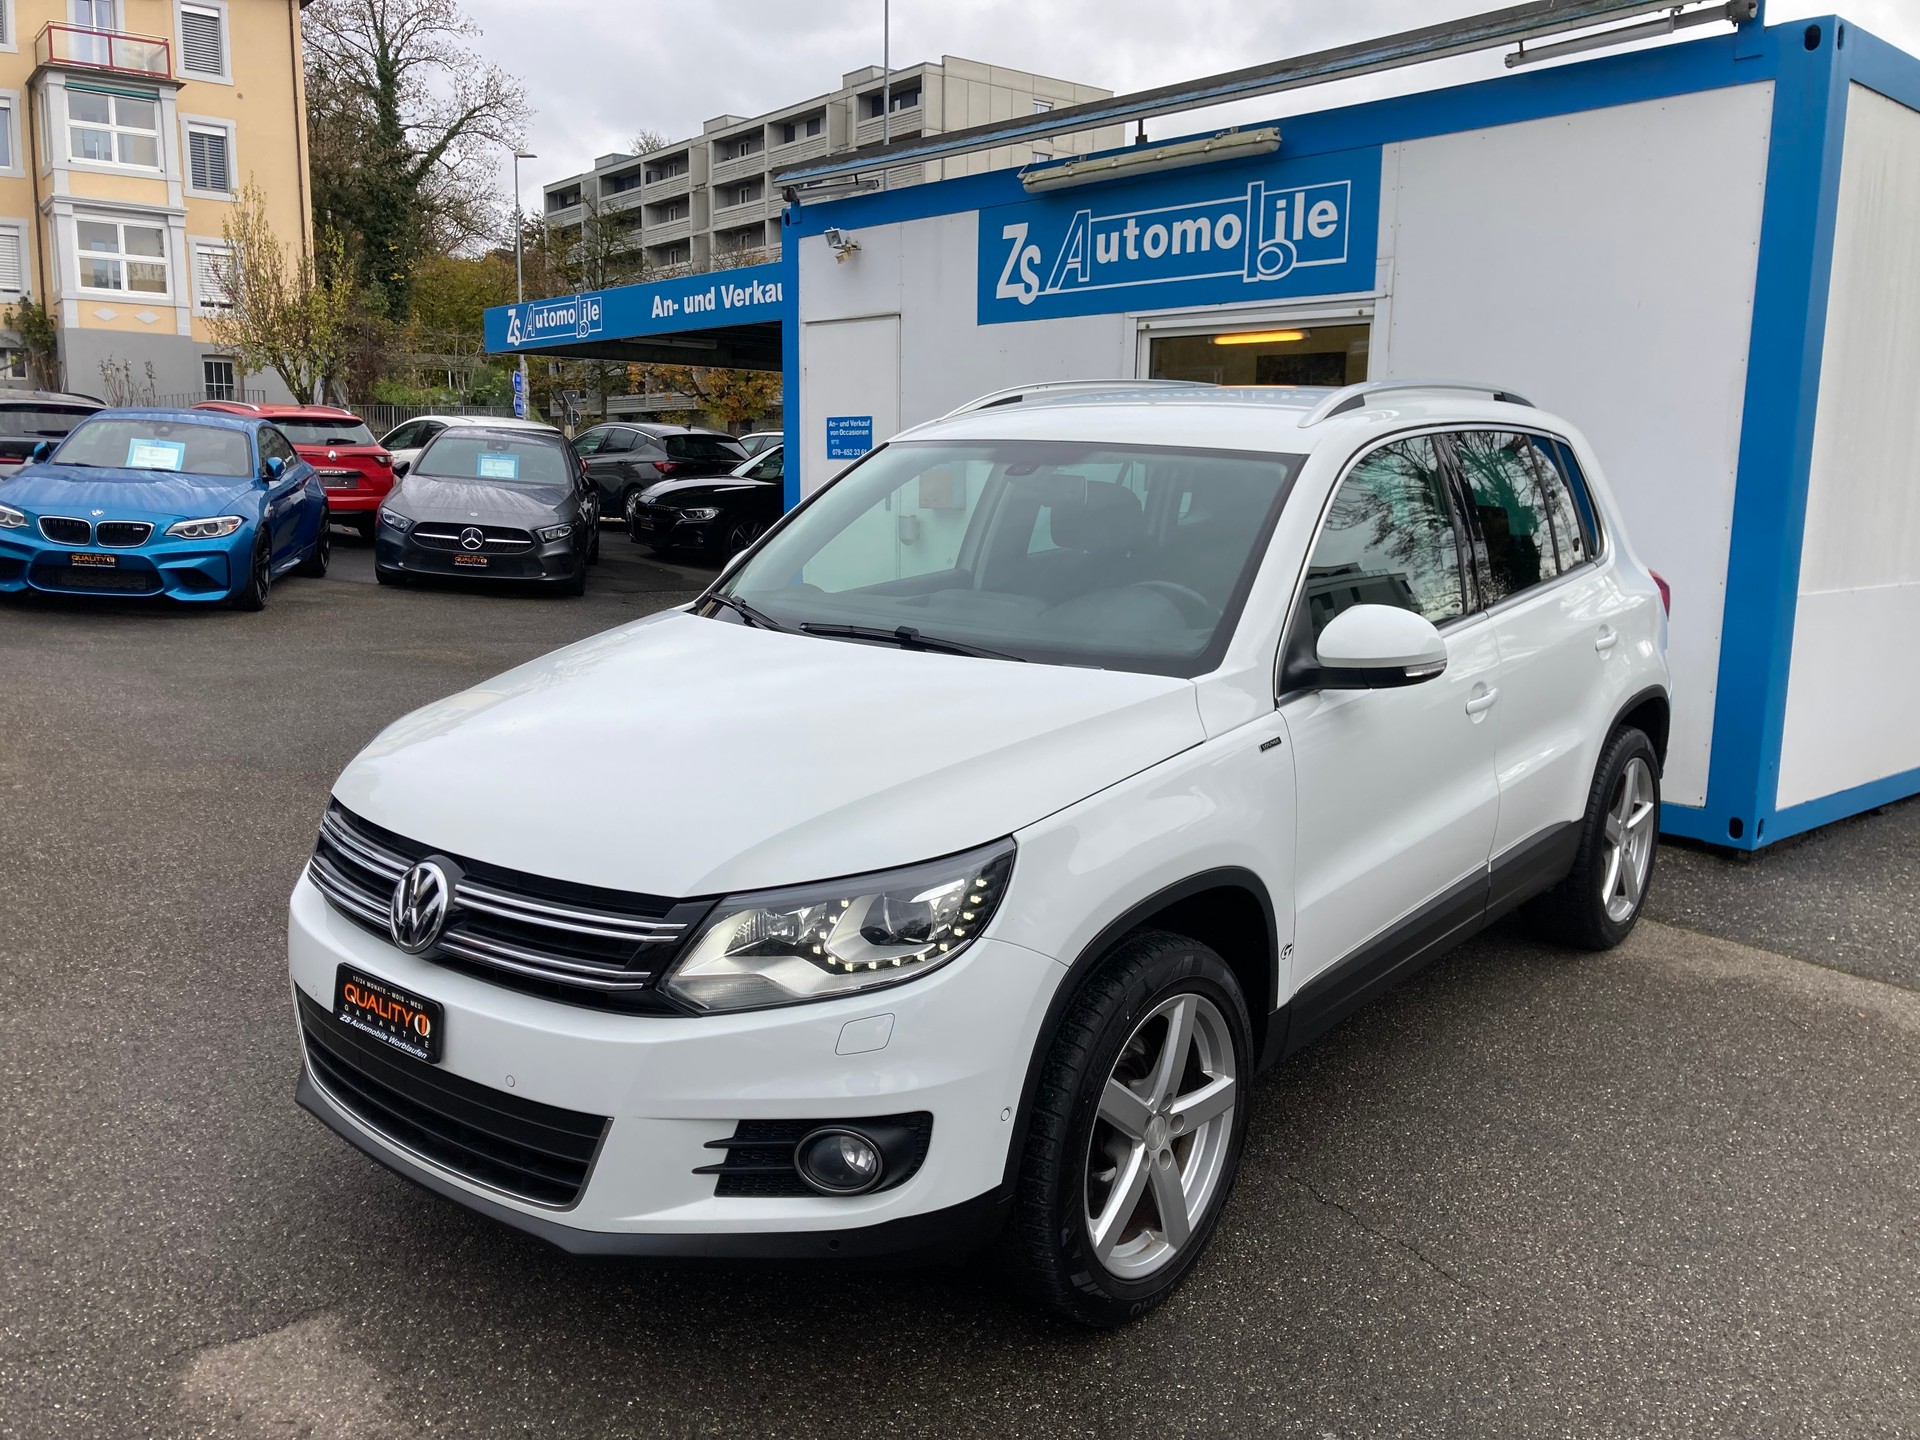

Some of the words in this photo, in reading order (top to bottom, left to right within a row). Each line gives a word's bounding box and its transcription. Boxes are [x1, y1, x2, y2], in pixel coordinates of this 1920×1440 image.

[1045, 181, 1339, 292] Automobile
[523, 296, 600, 340] Automobile
[651, 295, 679, 318] An-
[684, 286, 716, 314] und
[850, 419, 870, 427] Verkauf
[344, 983, 413, 1028] QUALITY
[353, 975, 366, 986] 12/24
[366, 981, 386, 995] MONATE
[391, 991, 405, 1003] MOIS
[410, 1000, 423, 1011] MESI
[339, 1014, 351, 1024] ZS
[351, 1019, 388, 1042] Automobile
[388, 1035, 428, 1060] Worblaufen
[344, 1004, 429, 1049] GARANTIE
